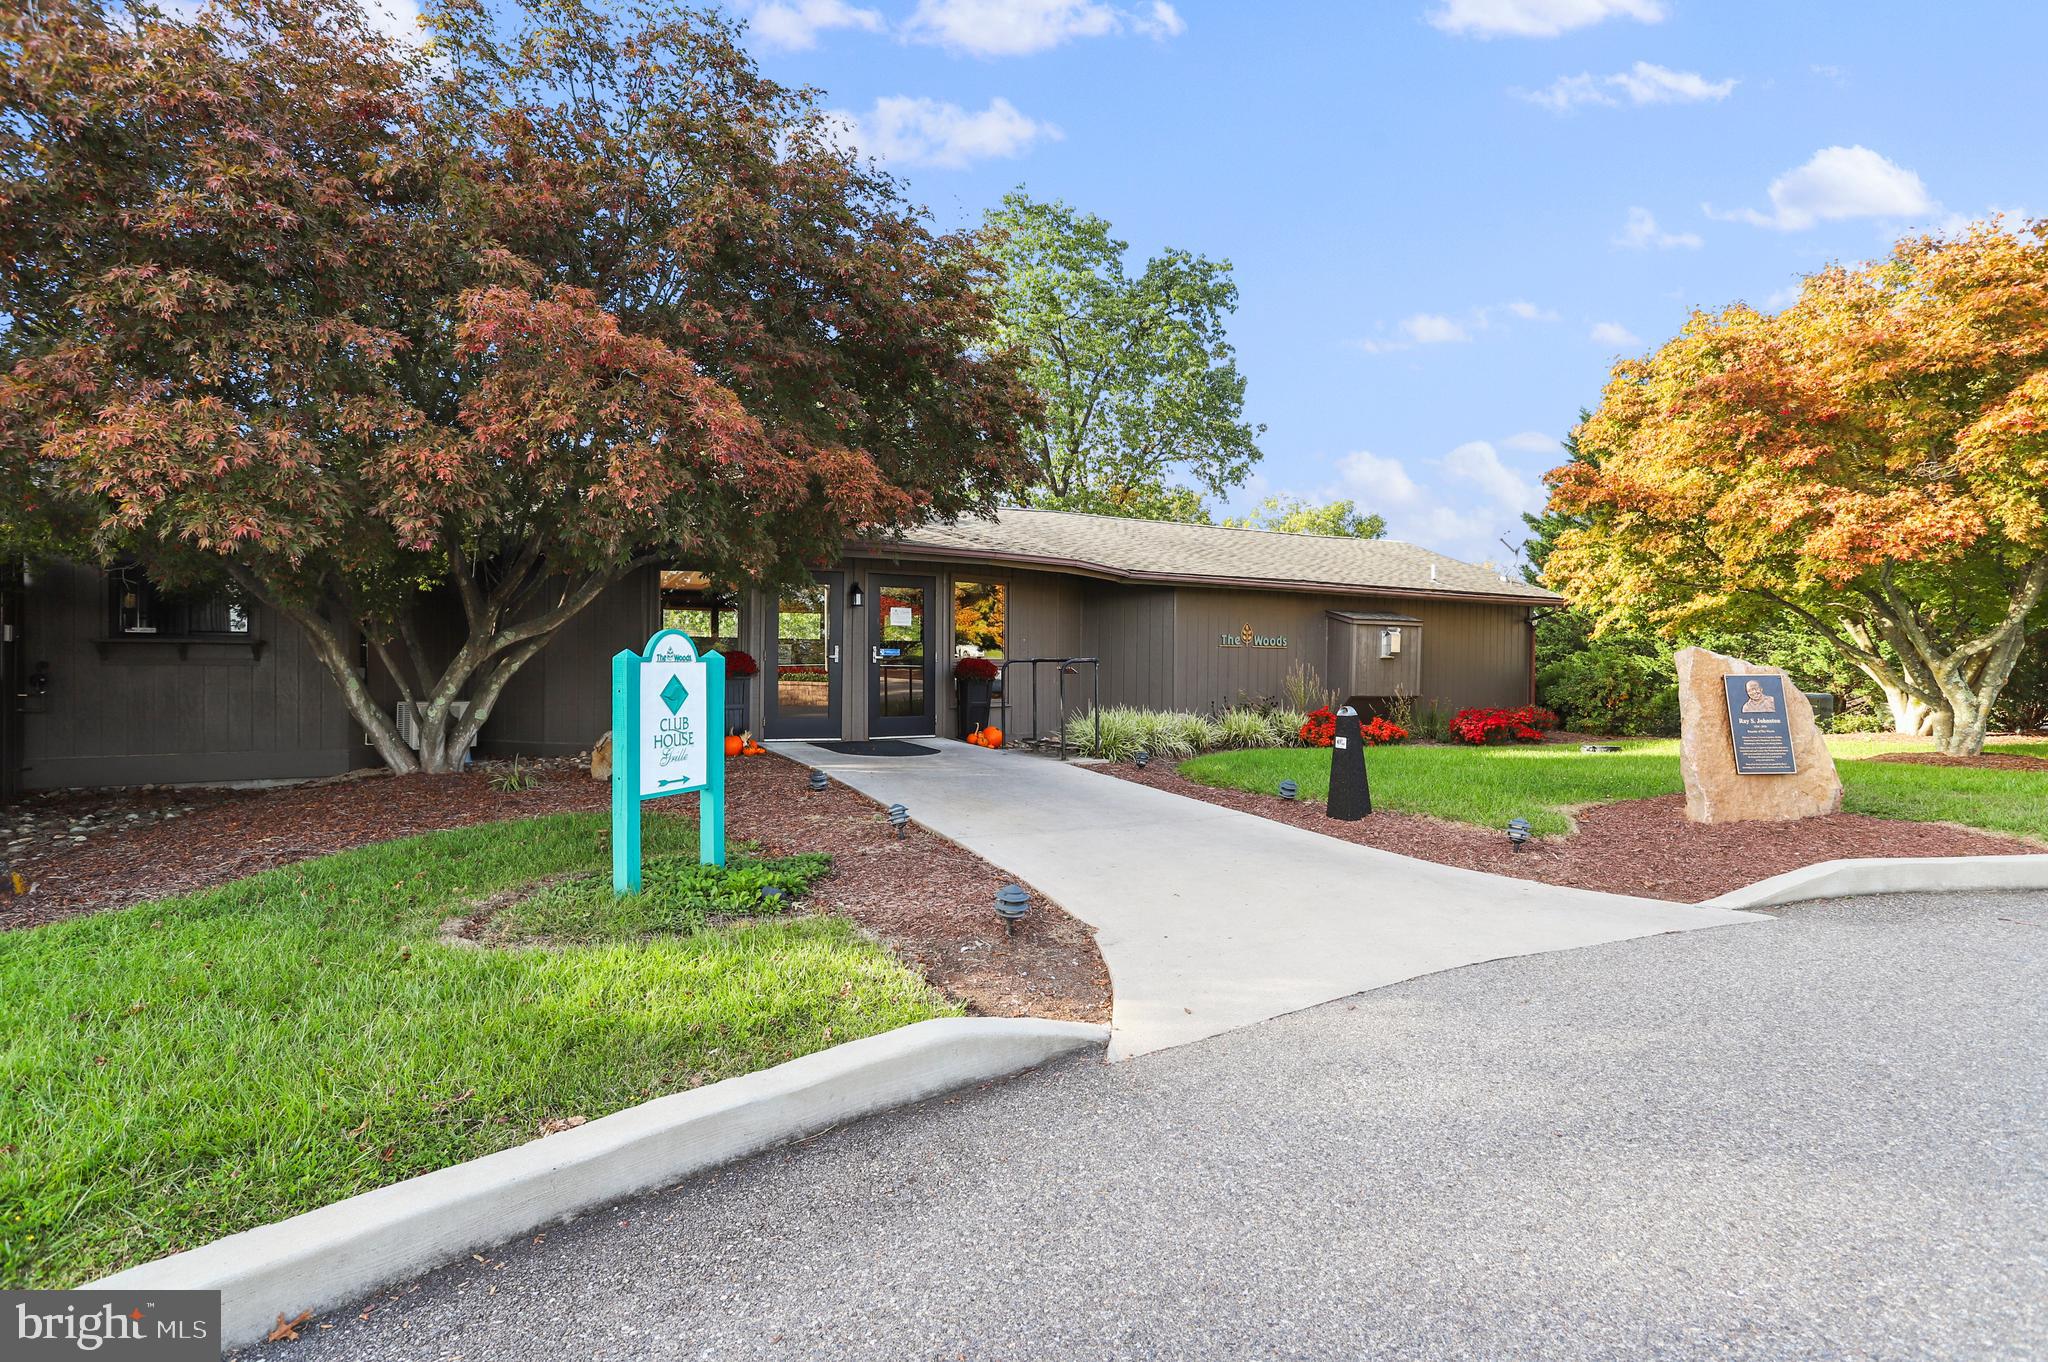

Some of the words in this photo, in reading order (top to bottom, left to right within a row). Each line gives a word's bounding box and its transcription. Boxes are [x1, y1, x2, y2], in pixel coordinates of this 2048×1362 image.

[1221, 634, 1240, 645] The
[1253, 634, 1288, 647] Woods
[656, 653, 667, 662] The
[674, 654, 692, 662] Woods
[660, 716, 689, 732] CLUB
[653, 731, 694, 749] HOUSE
[659, 747, 688, 767] Grille
